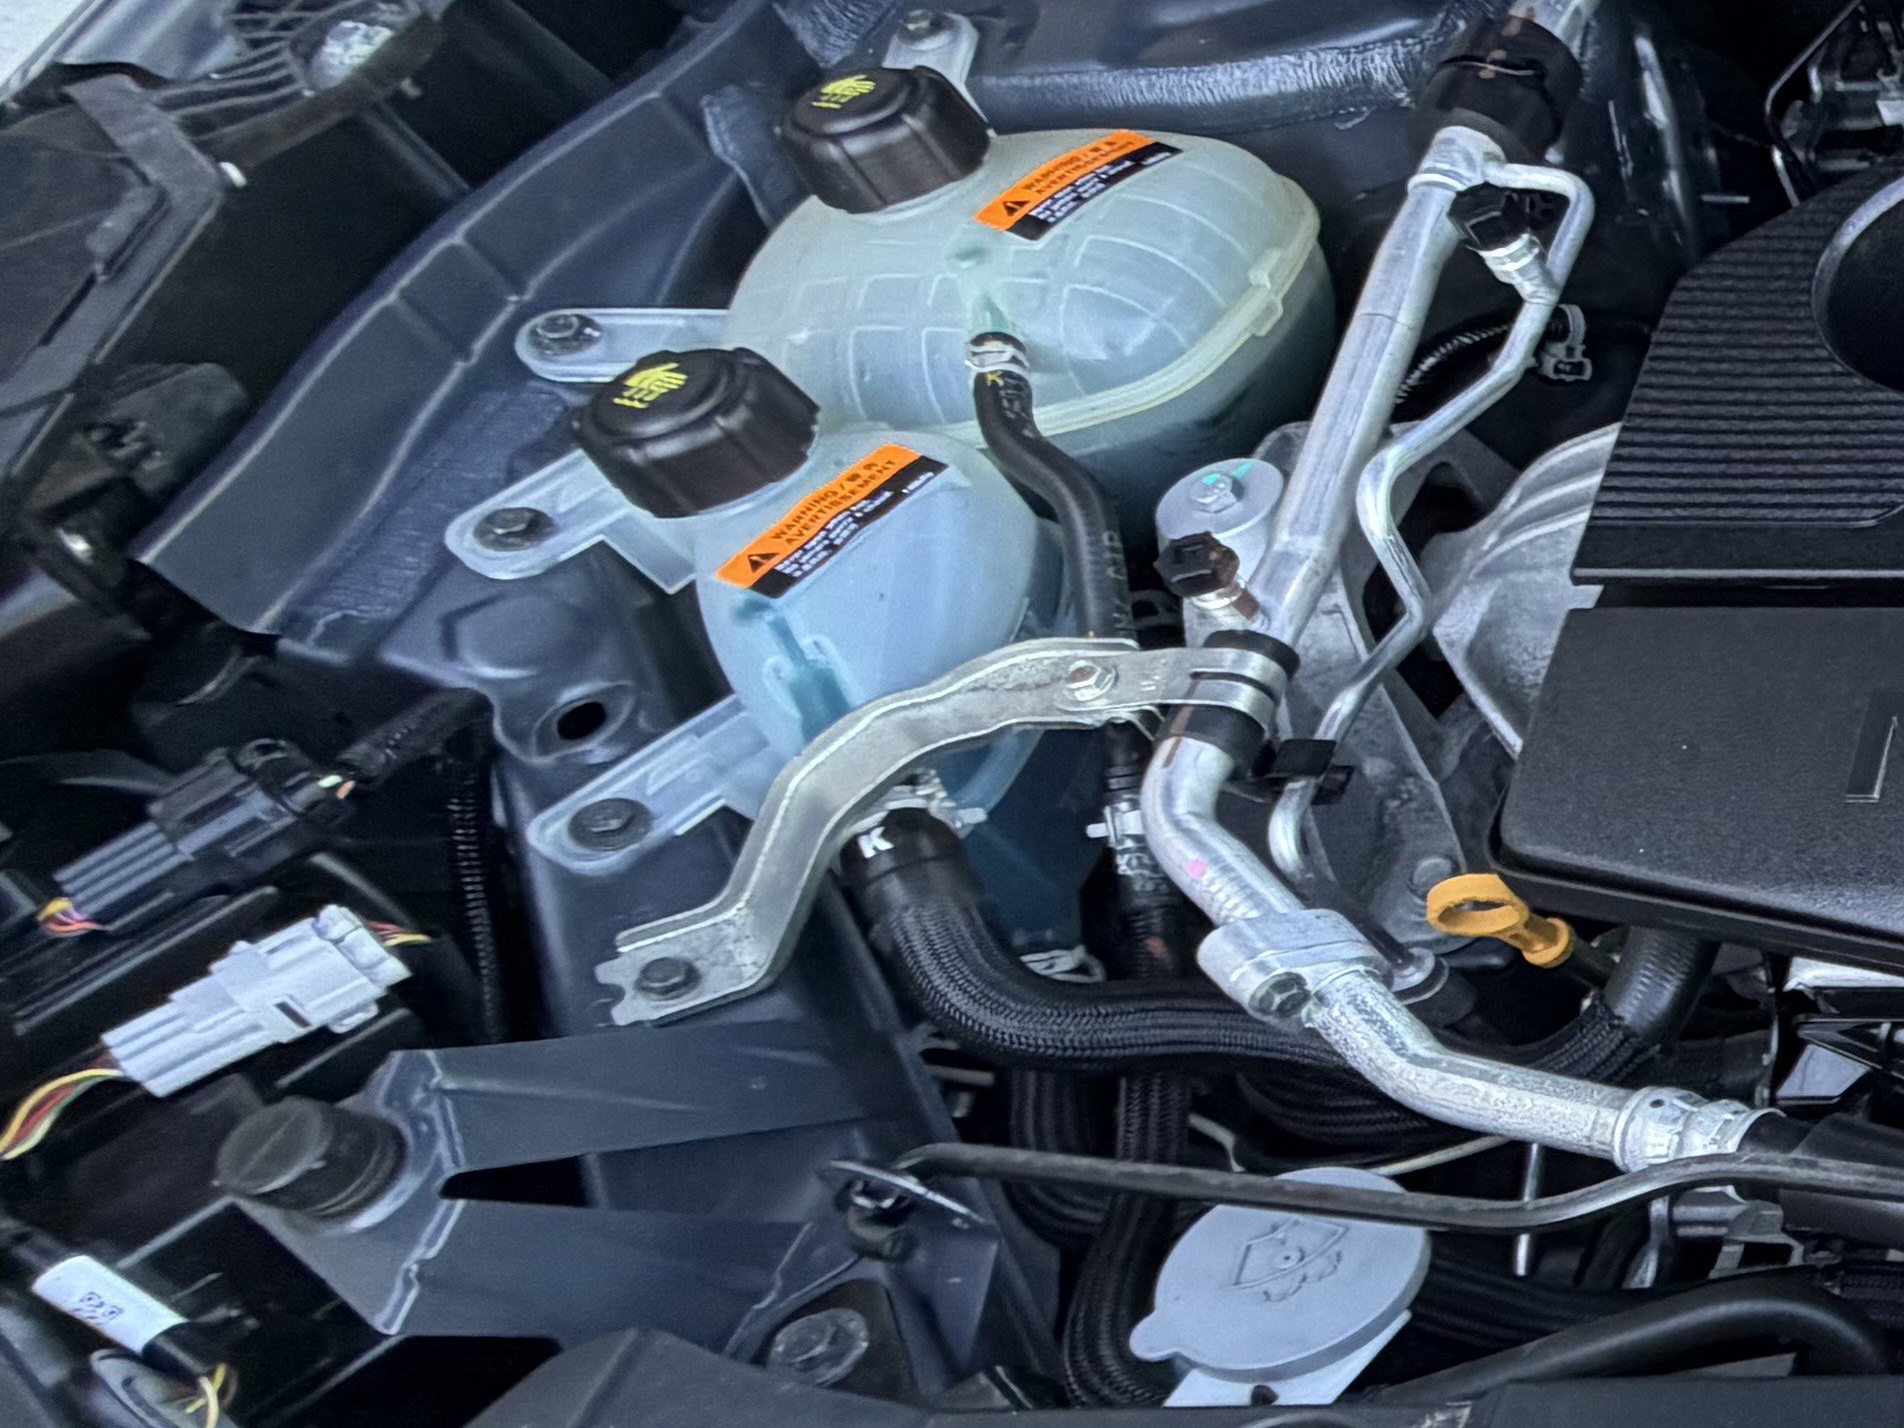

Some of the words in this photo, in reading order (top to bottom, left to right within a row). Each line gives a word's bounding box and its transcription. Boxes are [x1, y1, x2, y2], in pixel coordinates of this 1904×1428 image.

[769, 489, 840, 540] WARNING
[785, 460, 896, 546] AVERTISSEMENT
[857, 826, 895, 859] K
